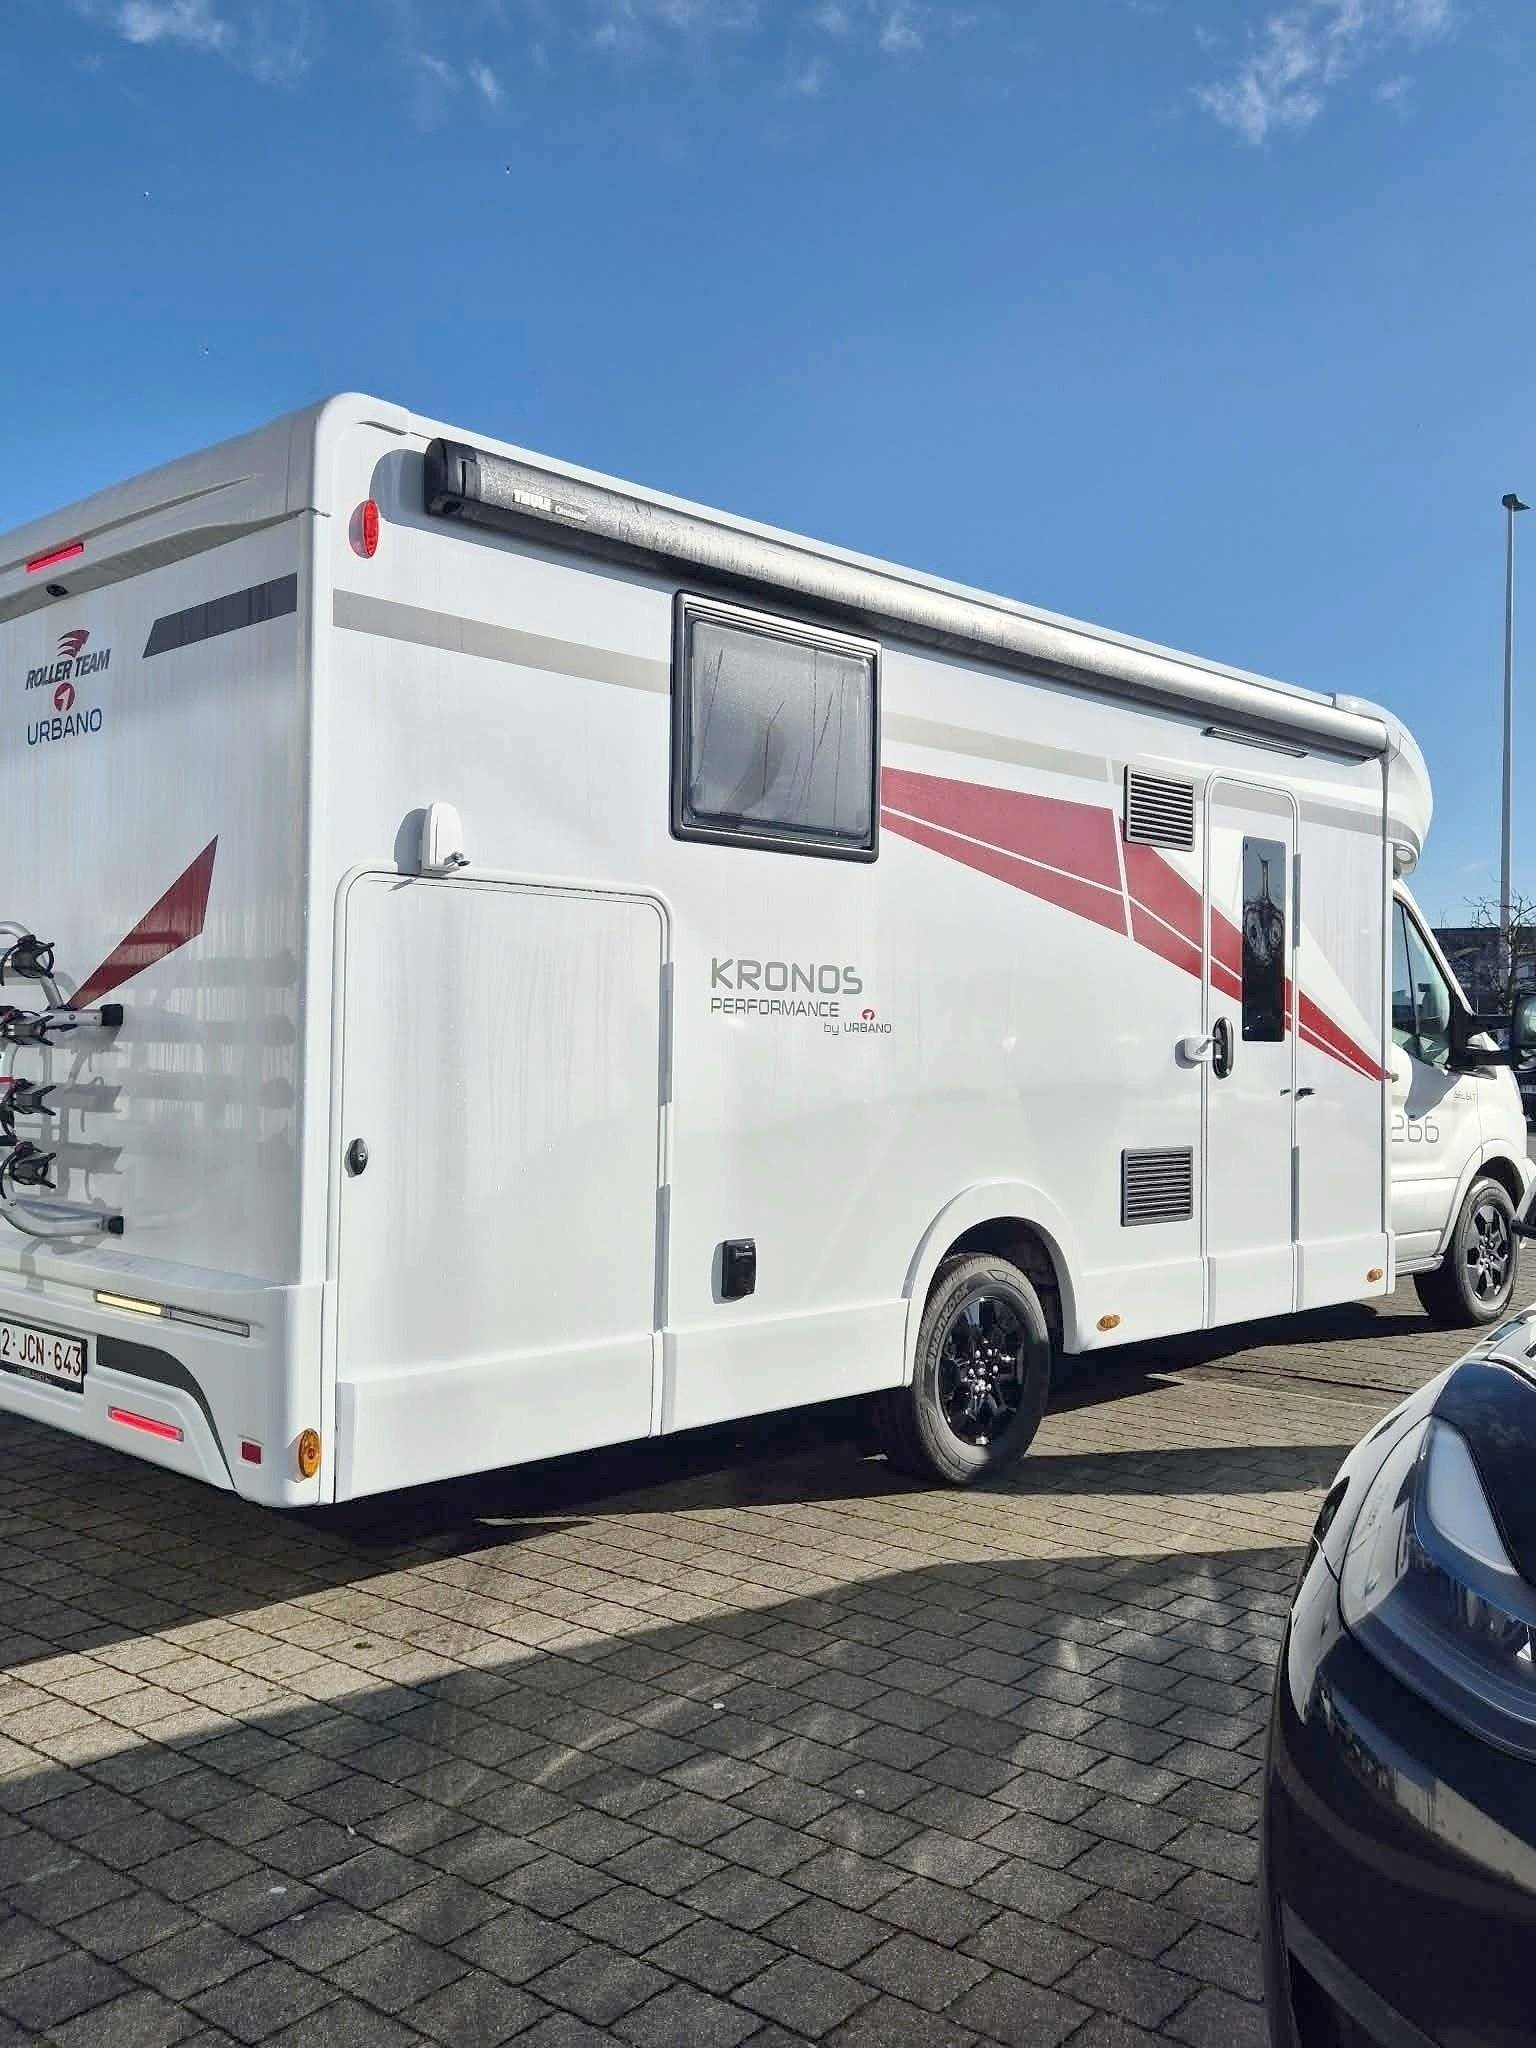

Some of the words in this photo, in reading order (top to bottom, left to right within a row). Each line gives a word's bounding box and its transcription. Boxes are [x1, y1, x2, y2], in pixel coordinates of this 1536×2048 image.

[25, 660, 73, 690] ROLLER
[74, 648, 112, 679] TEAM
[27, 708, 103, 746] URBANO
[711, 957, 863, 995] KRONOS
[710, 997, 840, 1018] PERFORMANCE
[823, 1022, 840, 1036] by
[843, 1023, 892, 1034] URBANO
